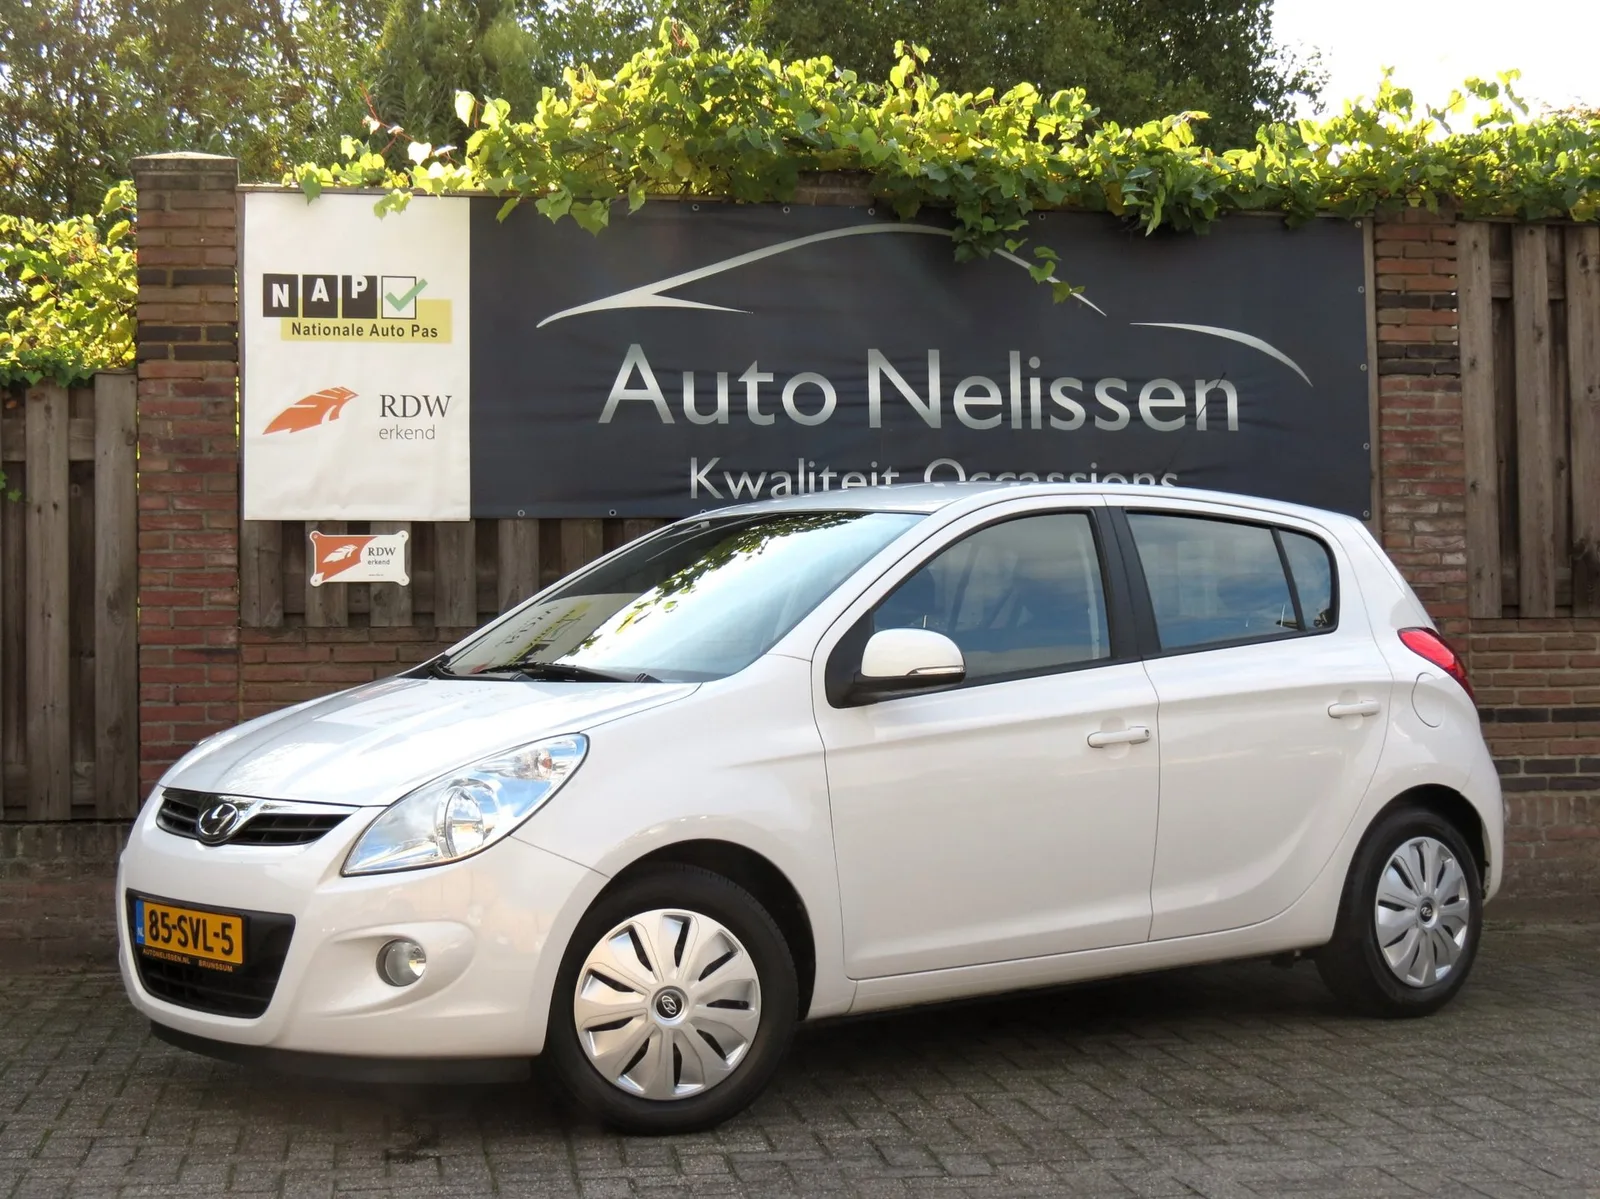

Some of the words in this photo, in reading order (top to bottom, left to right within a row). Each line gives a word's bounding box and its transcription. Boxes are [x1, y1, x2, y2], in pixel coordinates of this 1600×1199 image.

[272, 275, 368, 308] NAP
[291, 322, 364, 337] Nationale
[369, 324, 405, 337] Auto
[411, 324, 438, 338] Pas
[598, 343, 837, 427] Auto
[867, 348, 1239, 432] Nelissen
[379, 394, 452, 418] RDW
[378, 424, 436, 440] erkend
[368, 547, 396, 556] RDW
[148, 909, 234, 956] 85-SVL-5
[198, 959, 233, 973] BRUNSSUM
